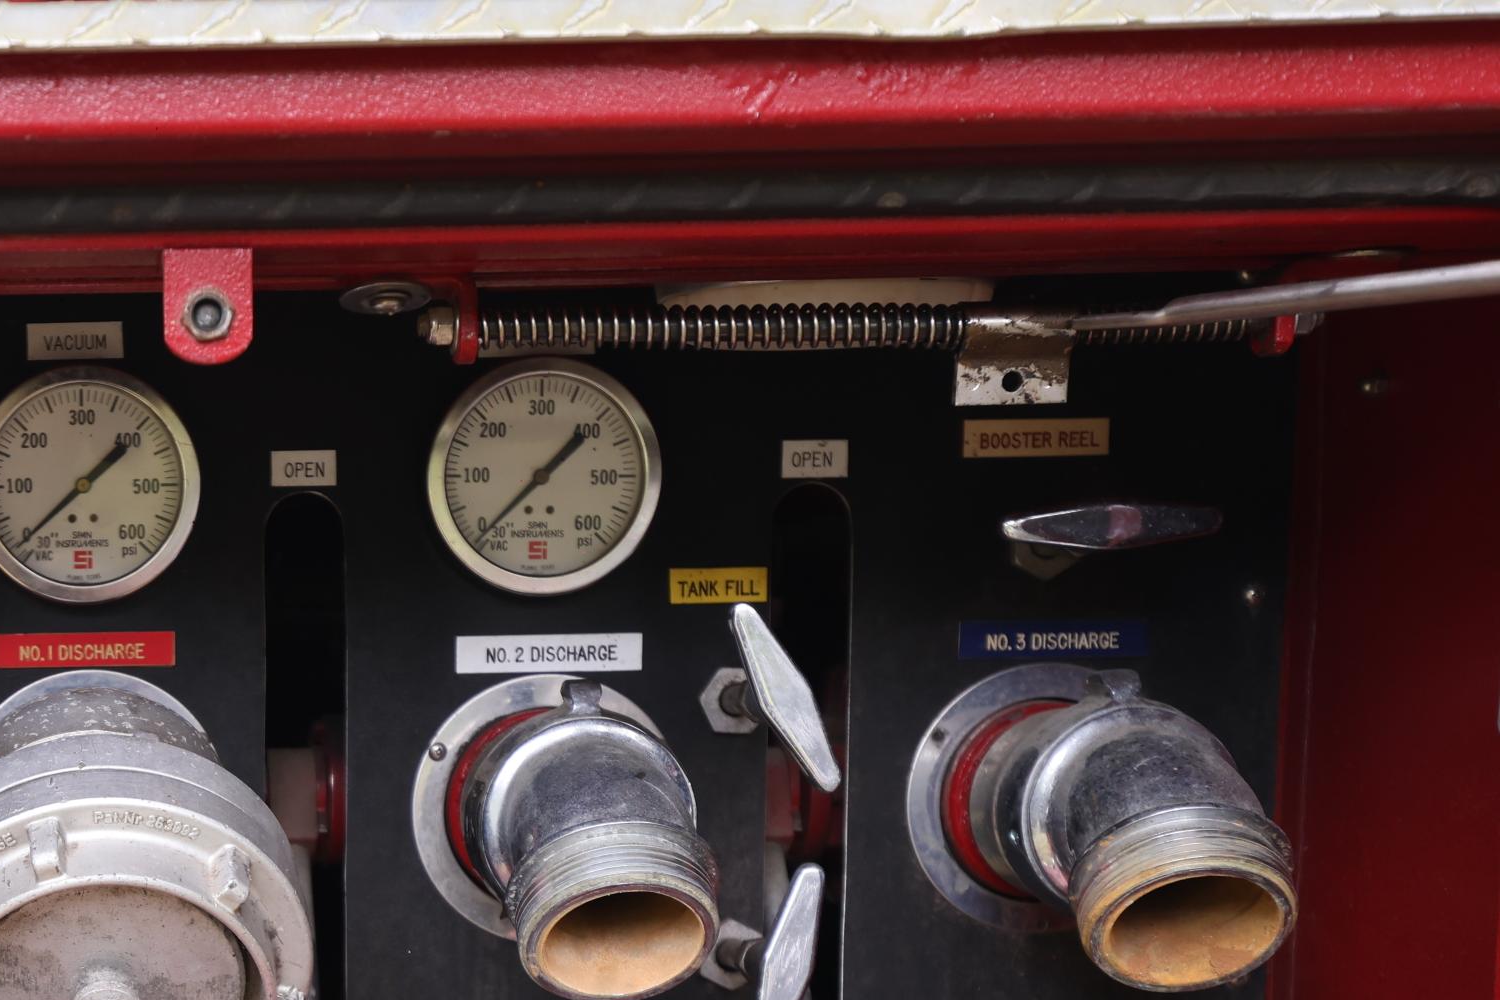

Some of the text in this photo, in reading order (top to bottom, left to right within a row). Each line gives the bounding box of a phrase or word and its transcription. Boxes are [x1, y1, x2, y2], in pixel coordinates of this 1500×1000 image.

[43, 333, 107, 351] VACUUM
[528, 399, 555, 416] 300
[68, 409, 95, 426] 300
[479, 422, 506, 438] 200
[573, 423, 600, 439] 400
[21, 432, 48, 449] 200
[115, 432, 141, 448] 400
[980, 430, 1100, 449] BOOSTER REEL
[791, 451, 833, 467] OPEN
[284, 462, 325, 478] OPEN
[464, 468, 490, 483] 100
[590, 469, 617, 485] 500
[7, 478, 33, 494] 100
[133, 478, 160, 494] 500
[477, 516, 487, 532] 0
[574, 514, 601, 531] 600
[119, 523, 146, 540] 600
[511, 530, 564, 538] INSTRUMENTS
[55, 539, 109, 548] INSTRUMENTS
[490, 540, 508, 552] VAC
[577, 534, 593, 549] psi
[35, 550, 54, 561] VAC
[121, 543, 138, 558] psi
[678, 579, 760, 597] TANK FILL
[986, 632, 1120, 651] NO. 3 DISCHARGE
[19, 645, 45, 662] NO.
[58, 643, 145, 661] DISCHARGE
[486, 644, 618, 664] NO. 2 DISCHARGE
